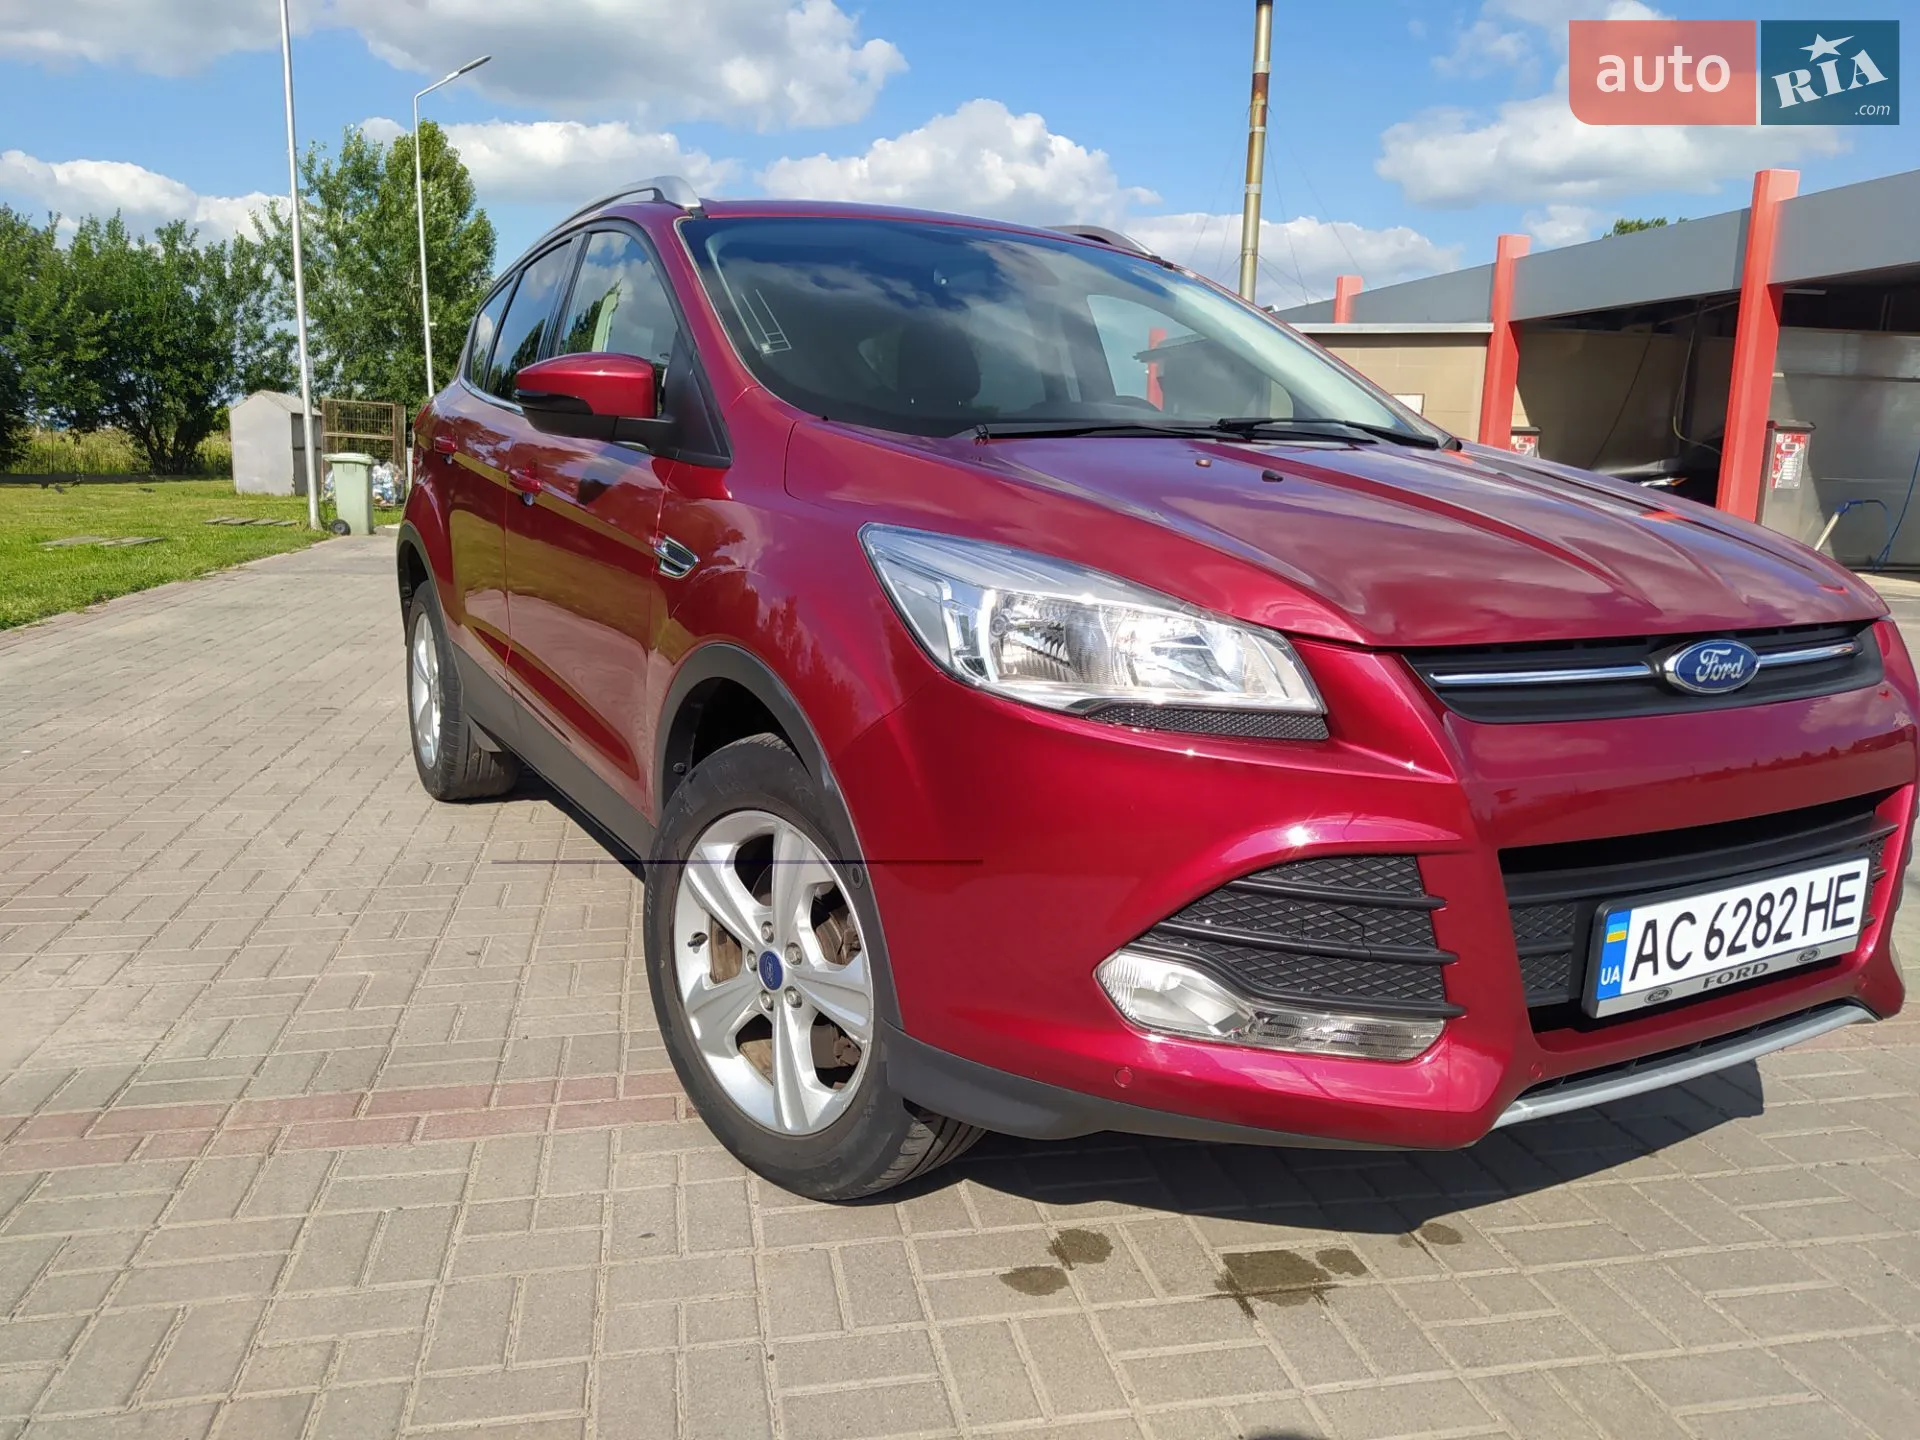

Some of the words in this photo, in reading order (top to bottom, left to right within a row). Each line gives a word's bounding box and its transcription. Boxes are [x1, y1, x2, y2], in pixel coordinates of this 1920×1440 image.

[1695, 648, 1745, 682] Ford
[1600, 965, 1620, 986] UA
[1702, 962, 1769, 989] FORD
